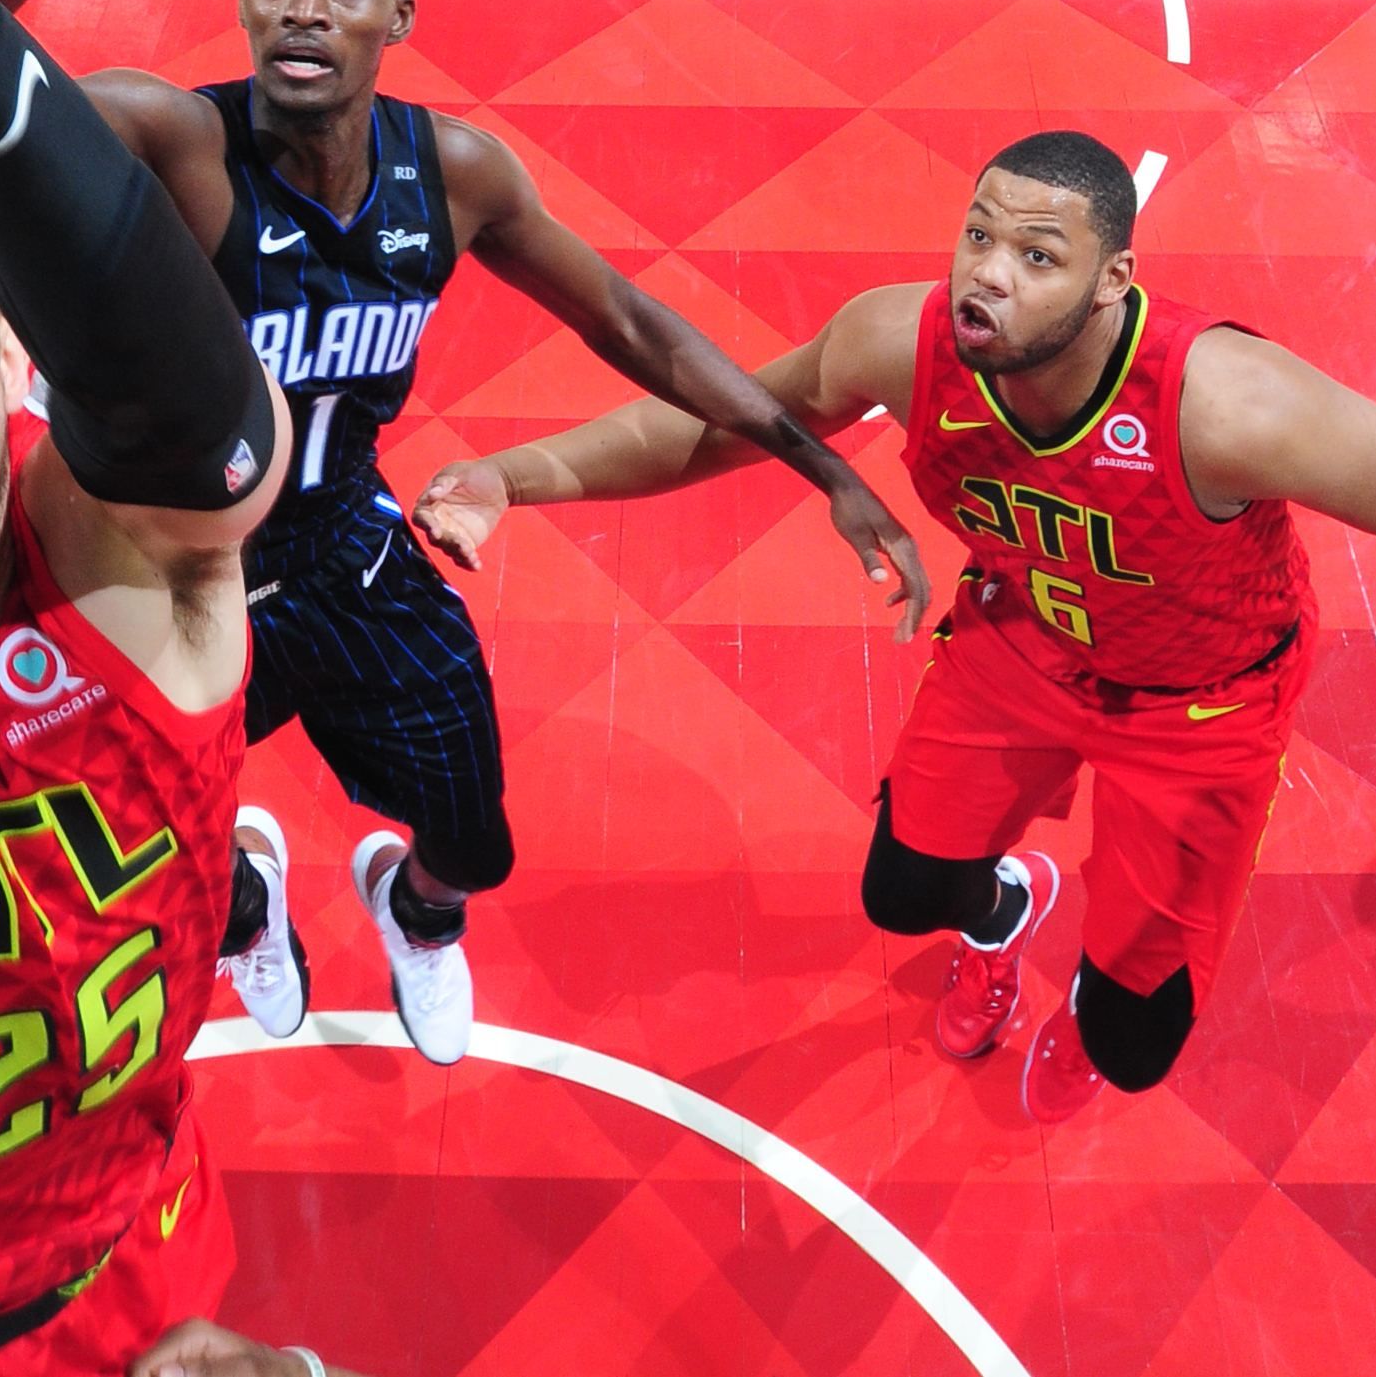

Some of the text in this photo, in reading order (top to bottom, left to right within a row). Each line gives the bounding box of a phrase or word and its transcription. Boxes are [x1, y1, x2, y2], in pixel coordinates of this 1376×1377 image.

[377, 228, 430, 255] Disney
[241, 295, 439, 386] RLAND
[299, 391, 345, 493] 1
[1094, 455, 1155, 472] sharecare
[953, 476, 1155, 585] ATL
[247, 579, 281, 605] AGIC
[1028, 566, 1096, 648] 6
[6, 684, 107, 748] sharecare
